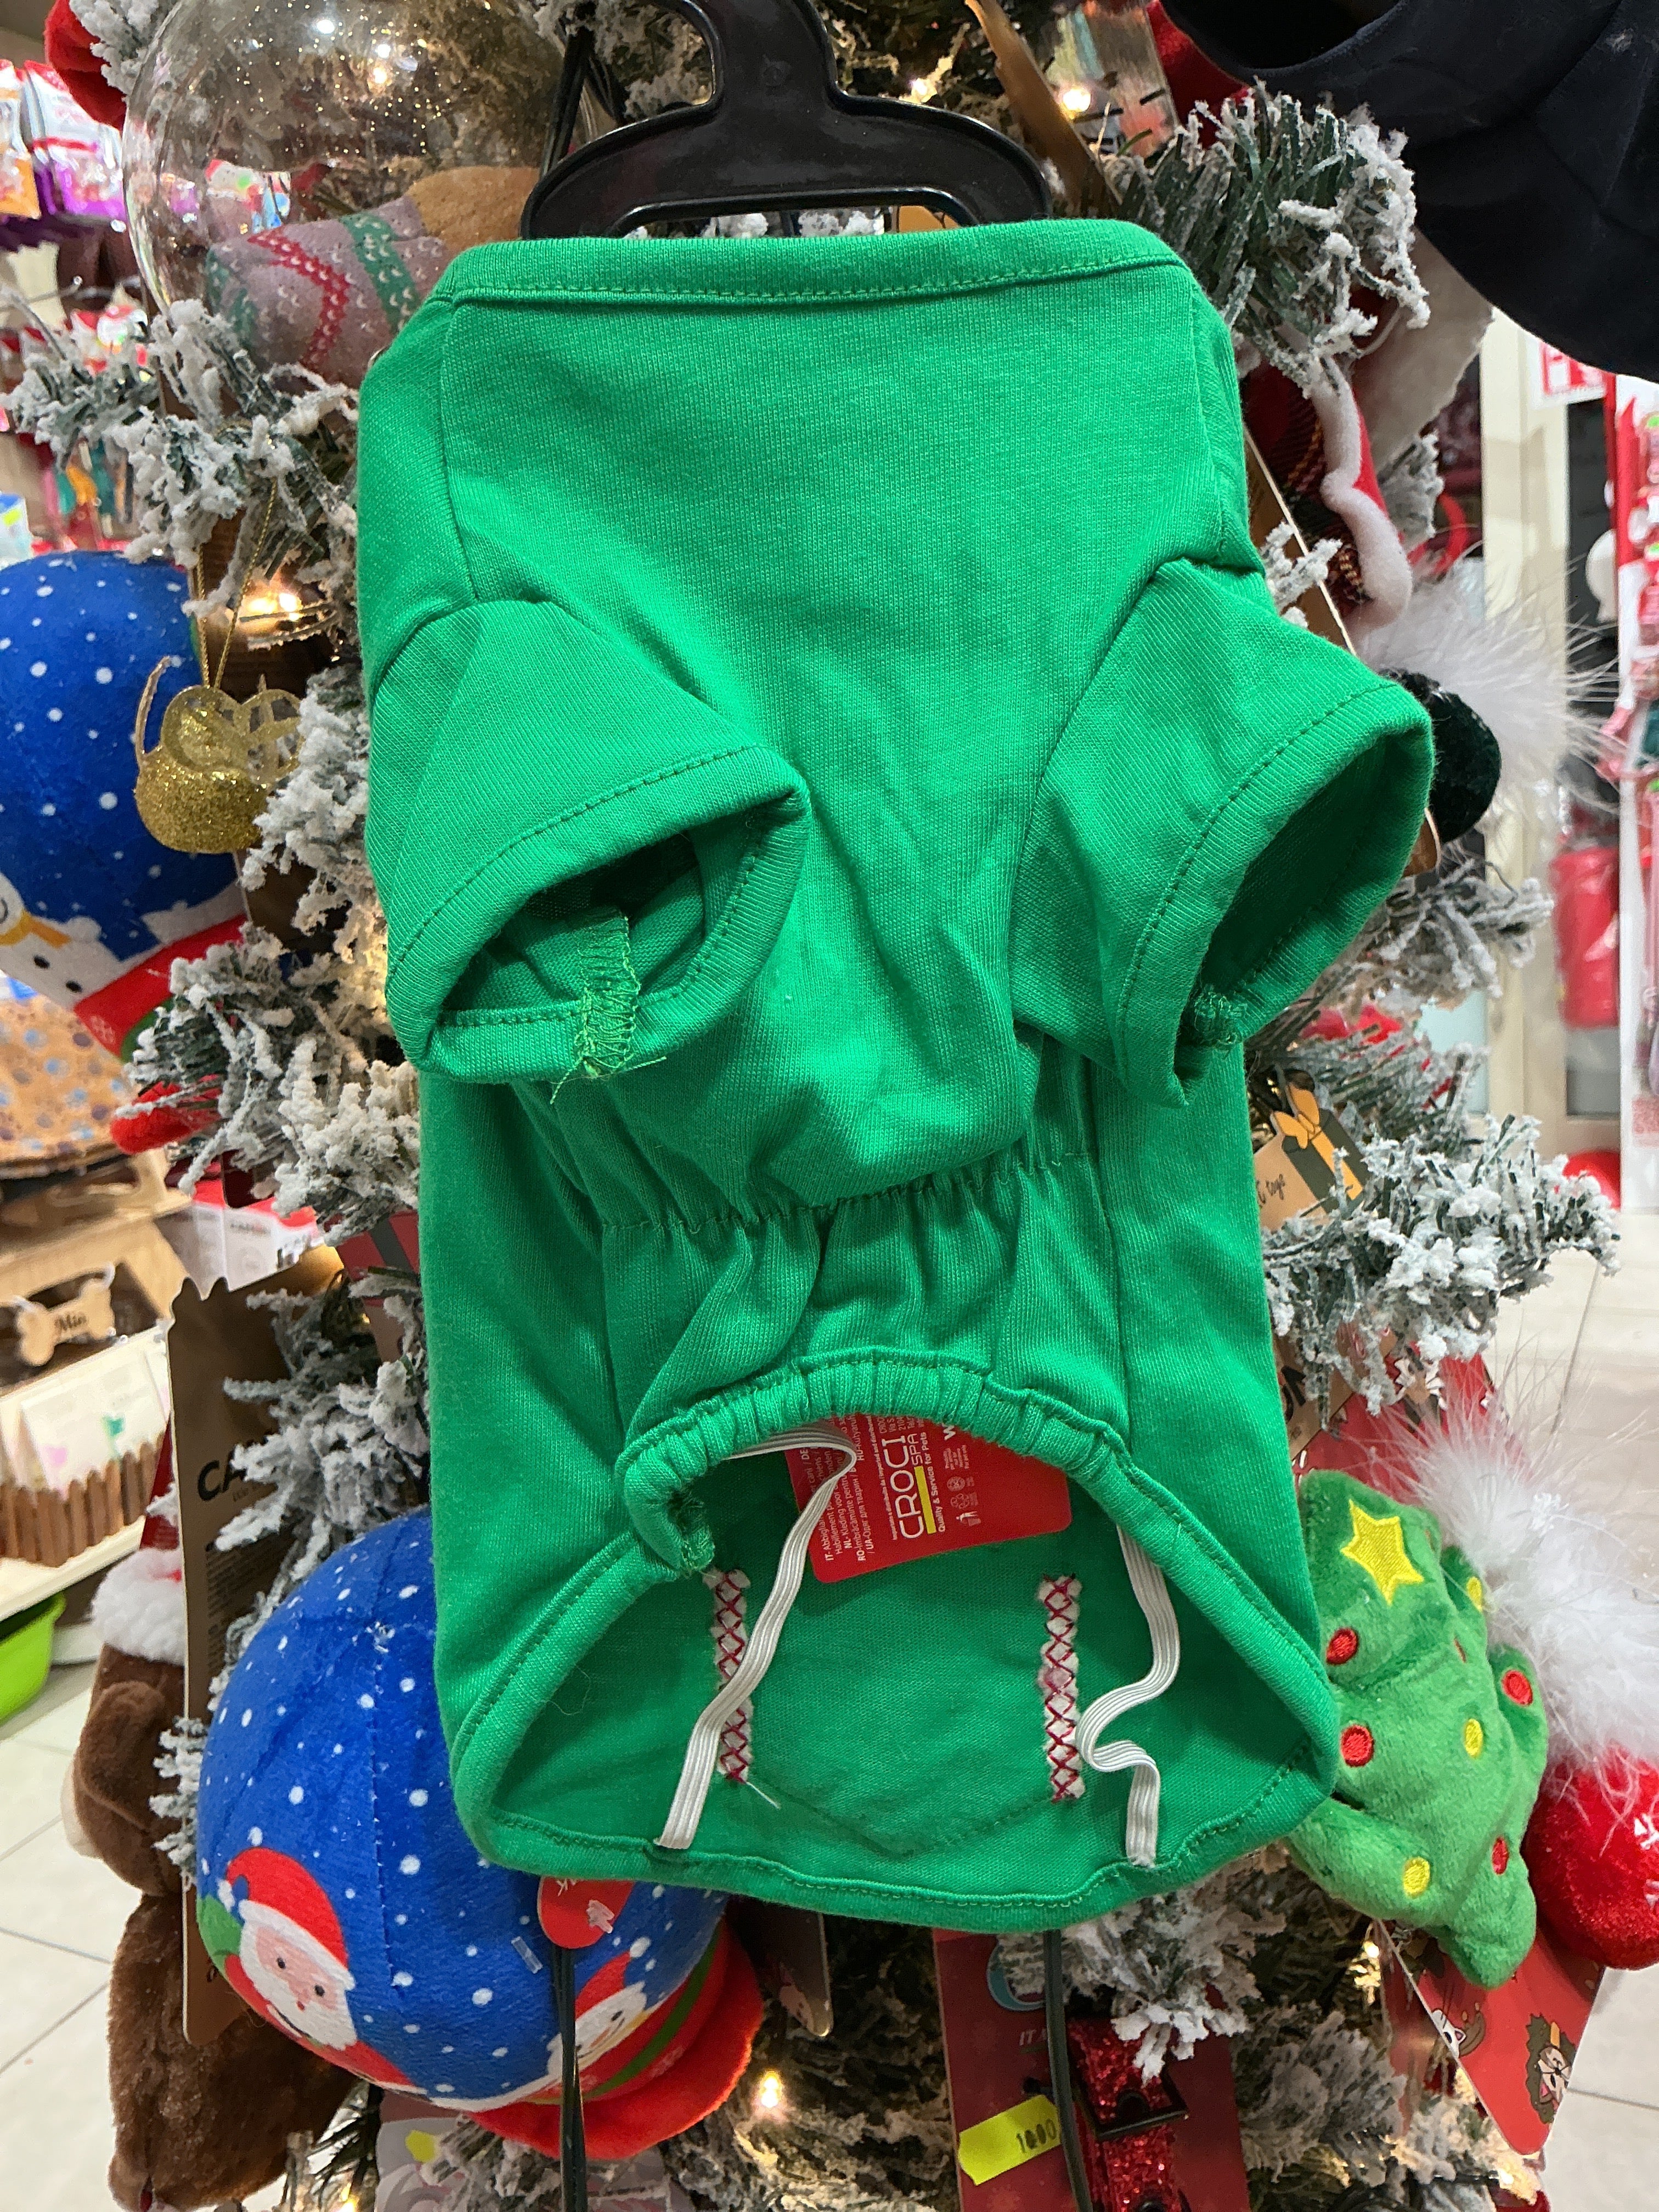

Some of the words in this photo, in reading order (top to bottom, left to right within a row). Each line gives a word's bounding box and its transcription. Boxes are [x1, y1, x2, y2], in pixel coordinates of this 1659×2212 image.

[876, 1415, 887, 1434] CROC
[907, 1434, 923, 1466] SPA
[919, 1432, 929, 1451] Pets
[881, 1435, 924, 1538] CROCI
[927, 1466, 938, 1496] Service
[815, 1516, 832, 1550] Abbiglia
[935, 1506, 945, 1532] Quality
